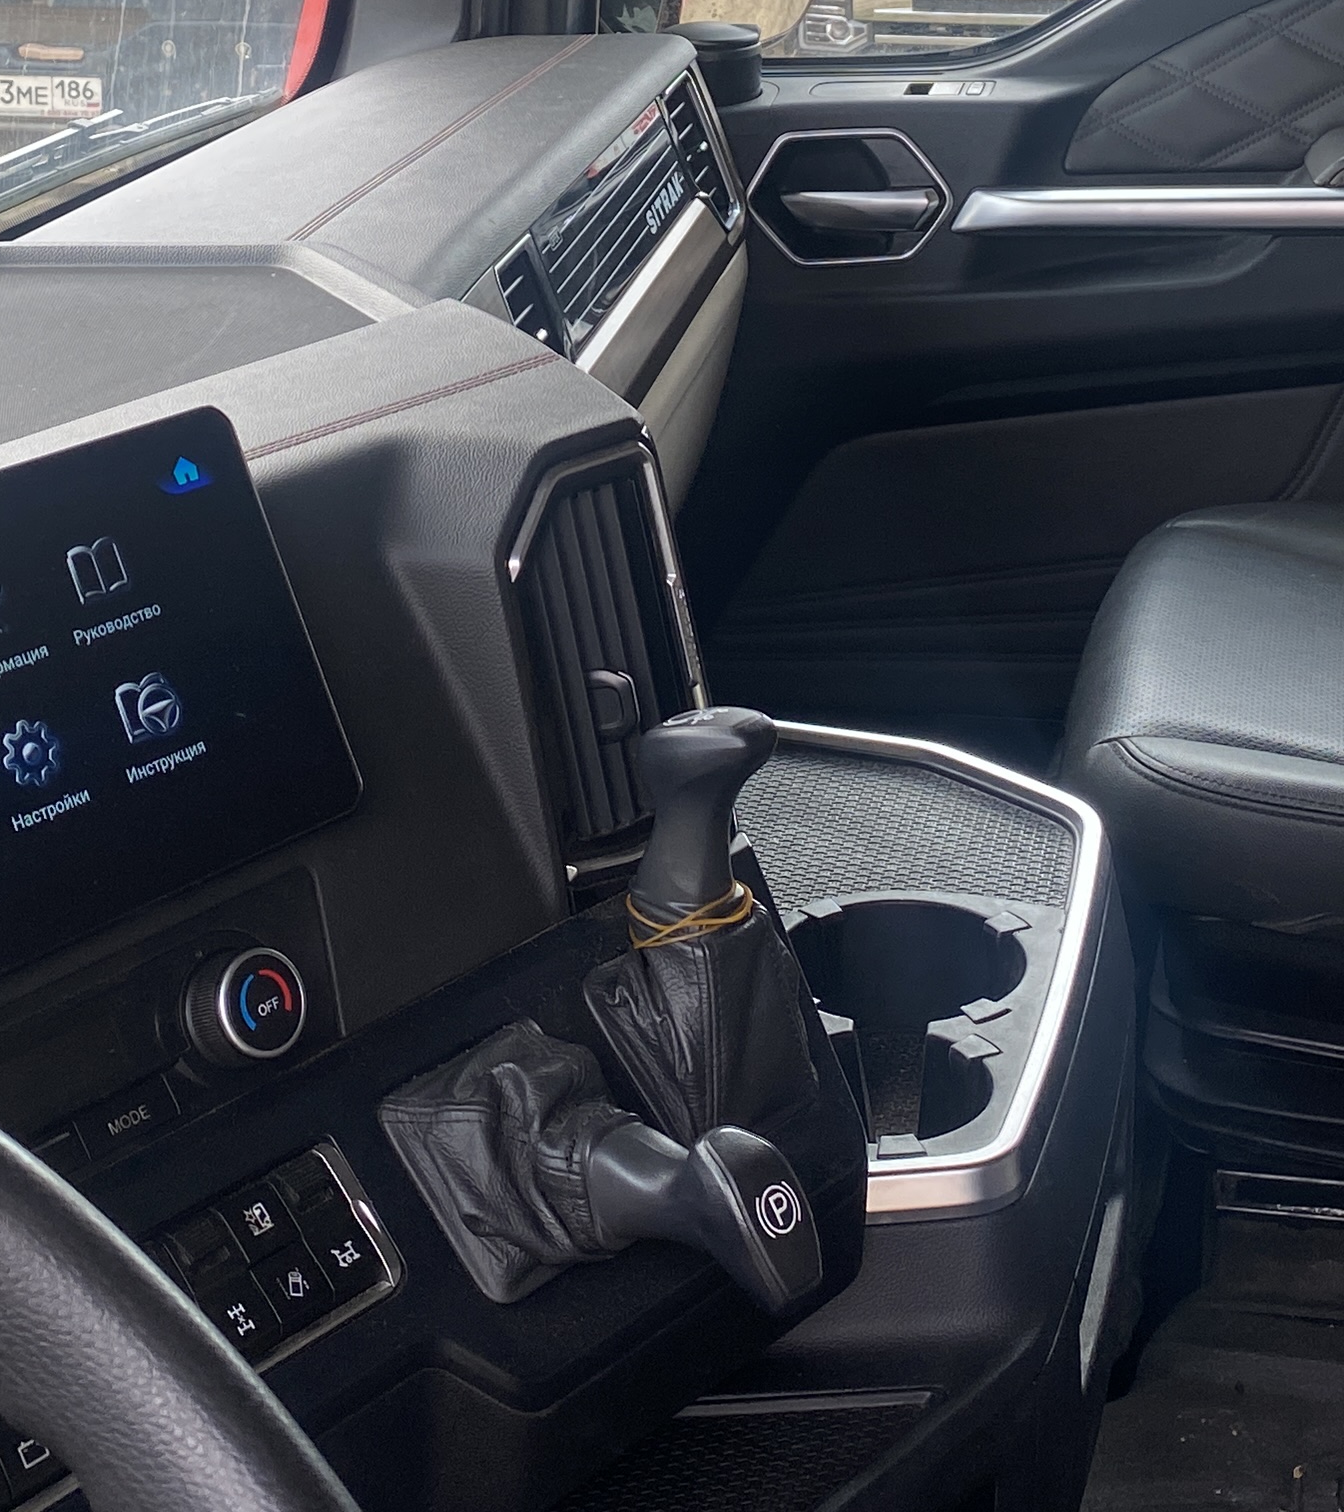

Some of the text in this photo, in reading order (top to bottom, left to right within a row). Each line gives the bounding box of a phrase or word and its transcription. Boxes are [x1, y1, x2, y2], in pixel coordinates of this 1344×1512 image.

[55, 80, 95, 100] 186
[645, 171, 685, 235] SITRAK
[72, 602, 162, 647] Руководство
[124, 739, 208, 785] Инструкция
[11, 788, 92, 833] Настройки
[257, 996, 279, 1017] OFF
[107, 1104, 151, 1136] MODE
